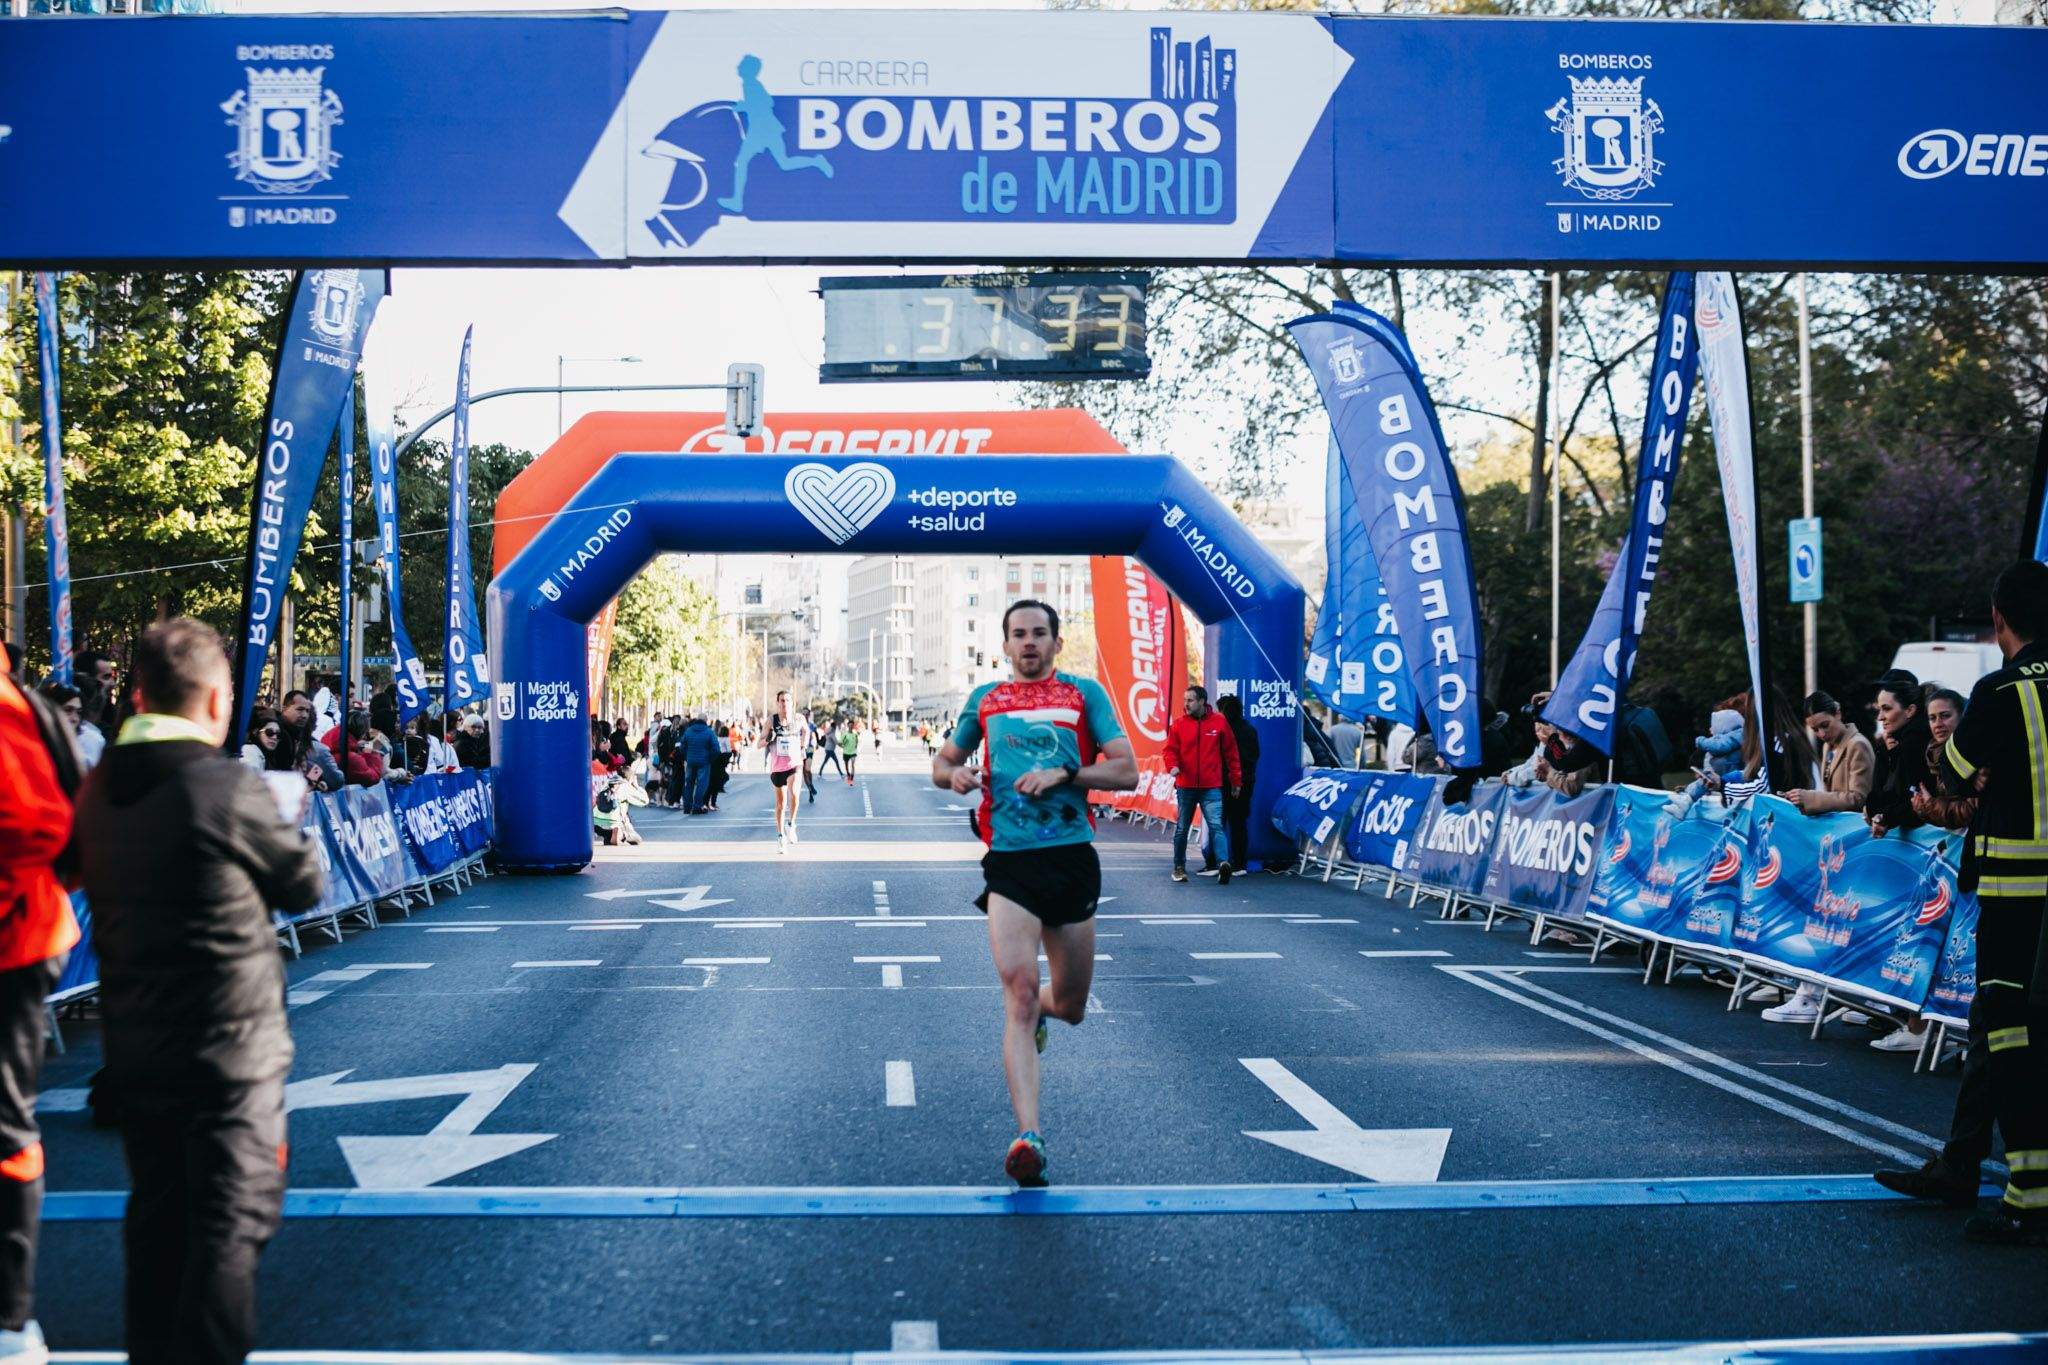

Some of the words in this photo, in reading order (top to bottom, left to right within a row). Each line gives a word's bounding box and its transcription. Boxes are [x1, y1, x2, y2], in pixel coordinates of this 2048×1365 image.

[236, 44, 334, 61] BOMBEROS
[1559, 53, 1653, 71] BOMBEROS
[800, 60, 930, 87] CARRERA
[801, 99, 1222, 153] BOMBEROS
[1965, 134, 2048, 176] ENE
[961, 157, 1018, 214] de
[1036, 157, 1223, 216] MADRID
[255, 207, 337, 225] MADRID
[1583, 214, 1661, 233] MADRID
[315, 350, 351, 370] MADRID
[870, 363, 899, 374] hour
[908, 486, 1017, 511] +deporte
[908, 512, 985, 531] +salud
[560, 507, 633, 581] MADRID
[1184, 526, 1255, 599] MADRID
[528, 681, 570, 696] Madrid
[1250, 679, 1291, 693] Madrid
[536, 694, 559, 709] es
[1258, 692, 1281, 706] es
[528, 706, 577, 722] Deporte
[1250, 704, 1296, 720] Deporte
